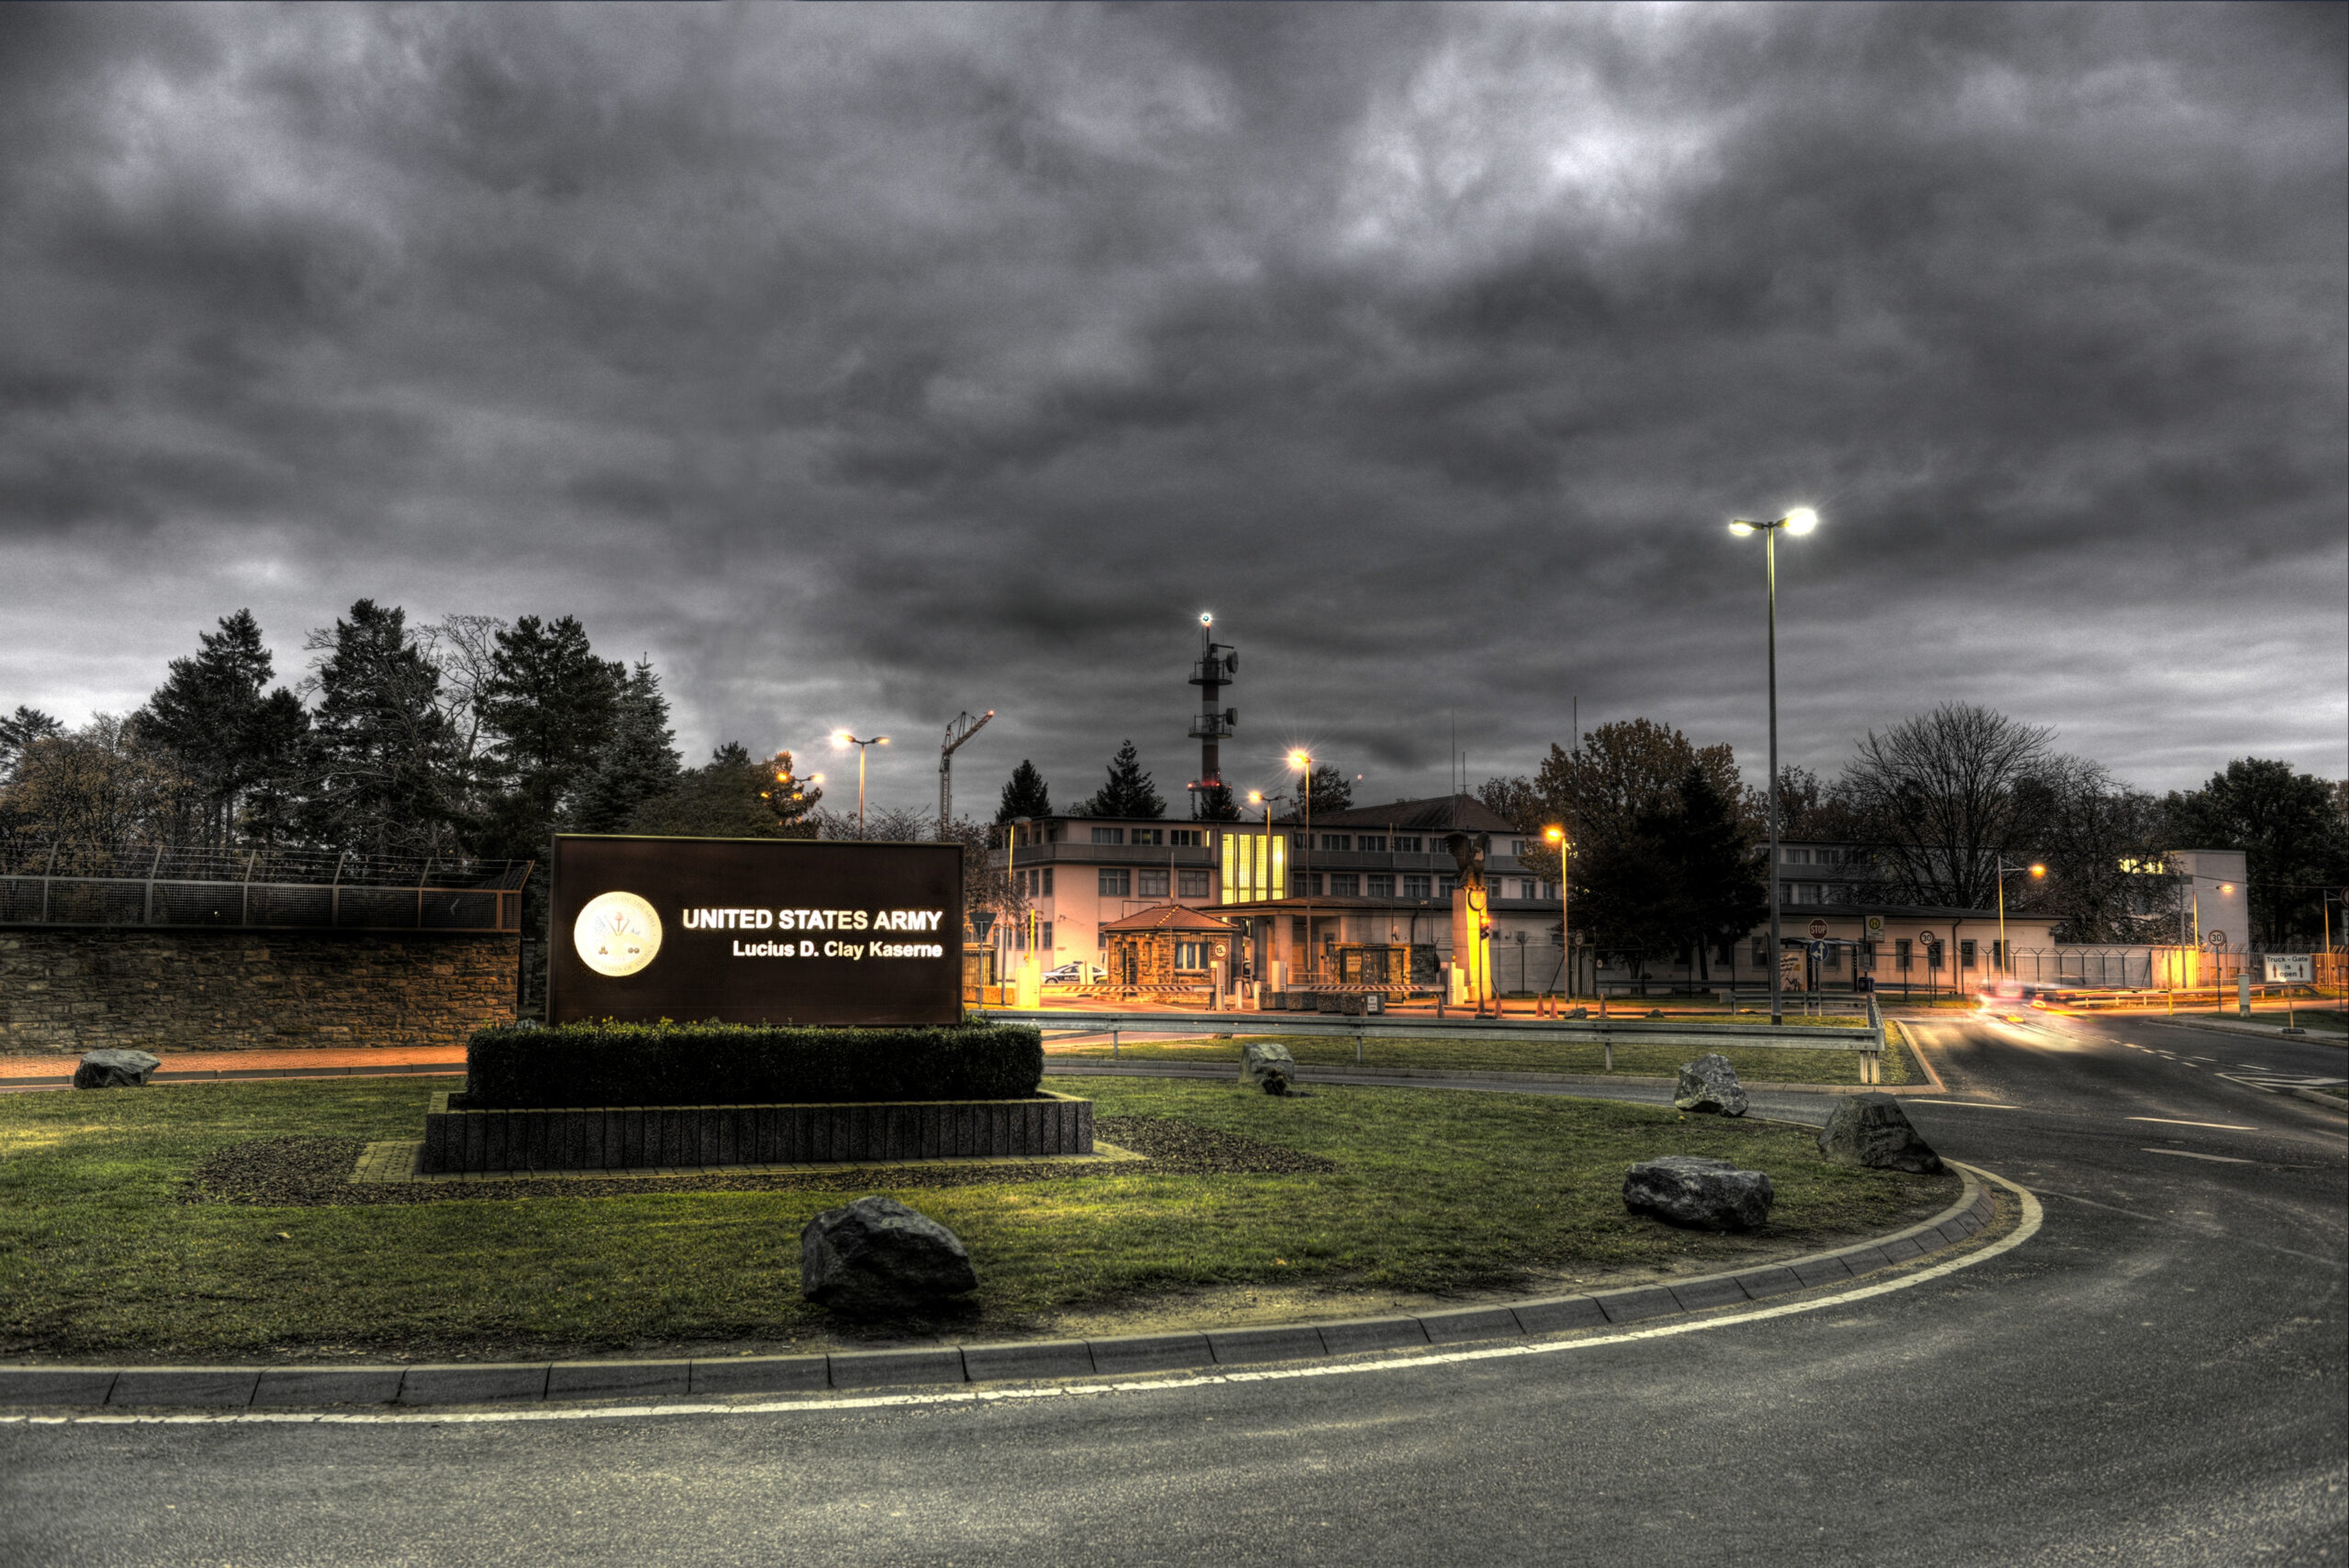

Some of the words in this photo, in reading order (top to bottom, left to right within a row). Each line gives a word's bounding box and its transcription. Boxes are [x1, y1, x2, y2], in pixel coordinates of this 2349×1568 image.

[682, 908, 773, 929] UNITED
[778, 909, 868, 930] STATES
[873, 910, 943, 931] ARMY
[1811, 925, 1826, 933] STOP
[733, 940, 795, 957] Lucius
[800, 940, 819, 957] D.
[824, 941, 864, 961] Clay
[870, 941, 943, 958] Kaserne
